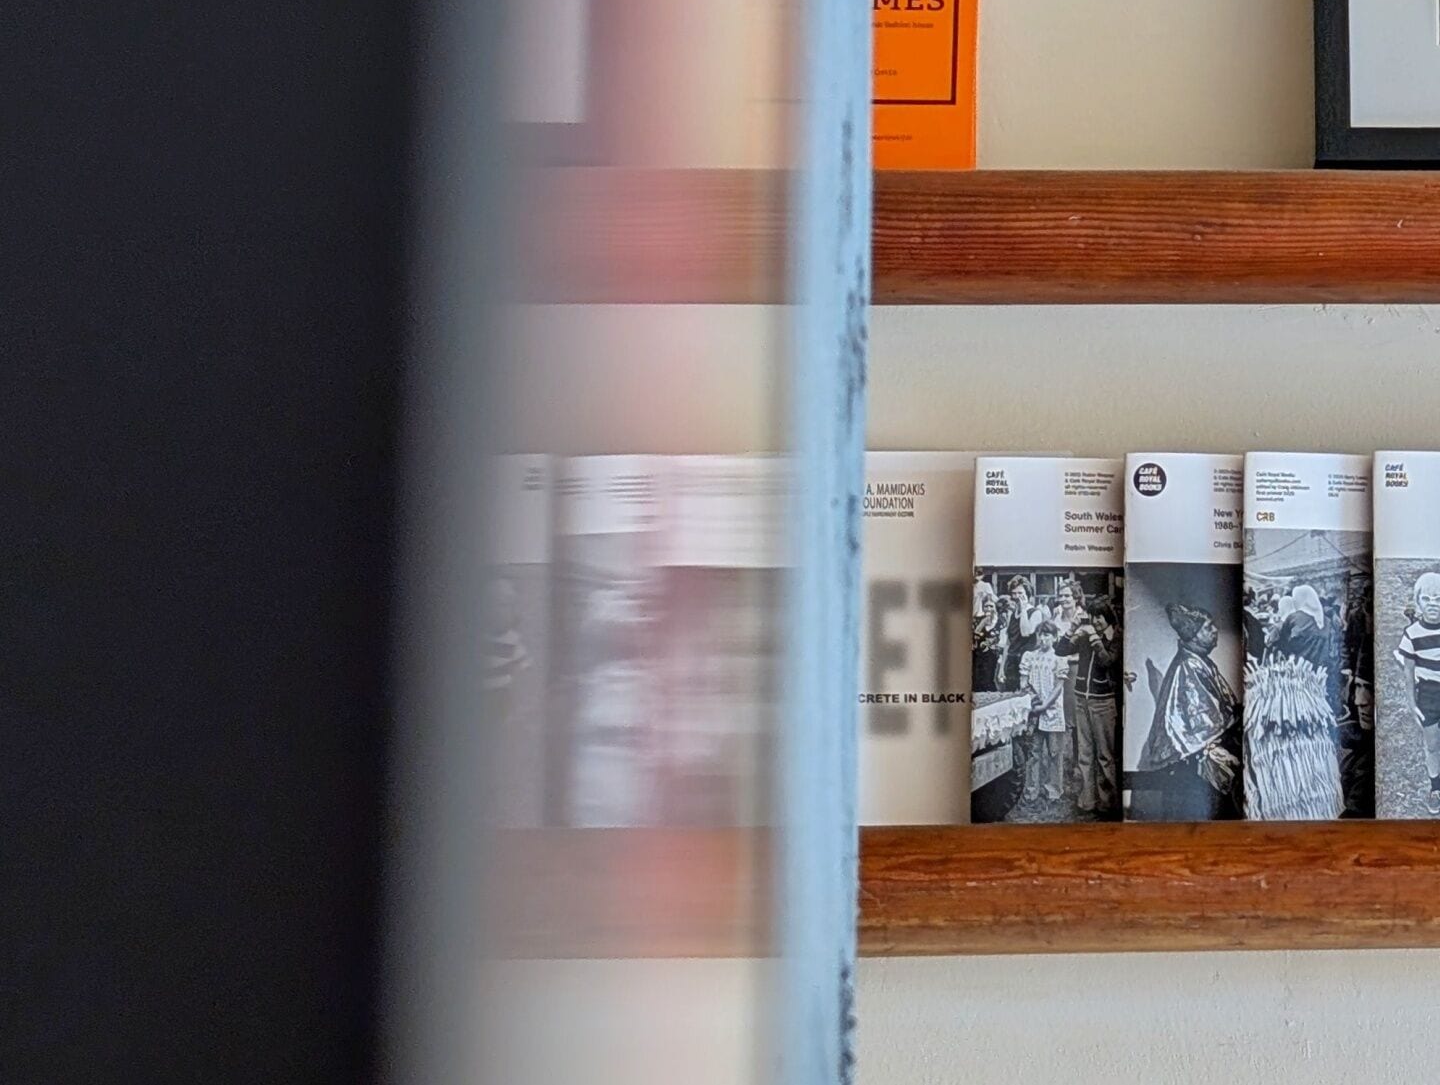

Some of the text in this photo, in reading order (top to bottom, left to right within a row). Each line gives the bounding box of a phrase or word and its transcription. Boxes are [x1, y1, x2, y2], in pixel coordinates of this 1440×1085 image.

[876, 483, 926, 496] MAMIDAKIS
[1064, 511, 1093, 521] South
[1064, 524, 1105, 534] Summer
[904, 694, 918, 704] IN
[922, 694, 965, 704] BLACK
